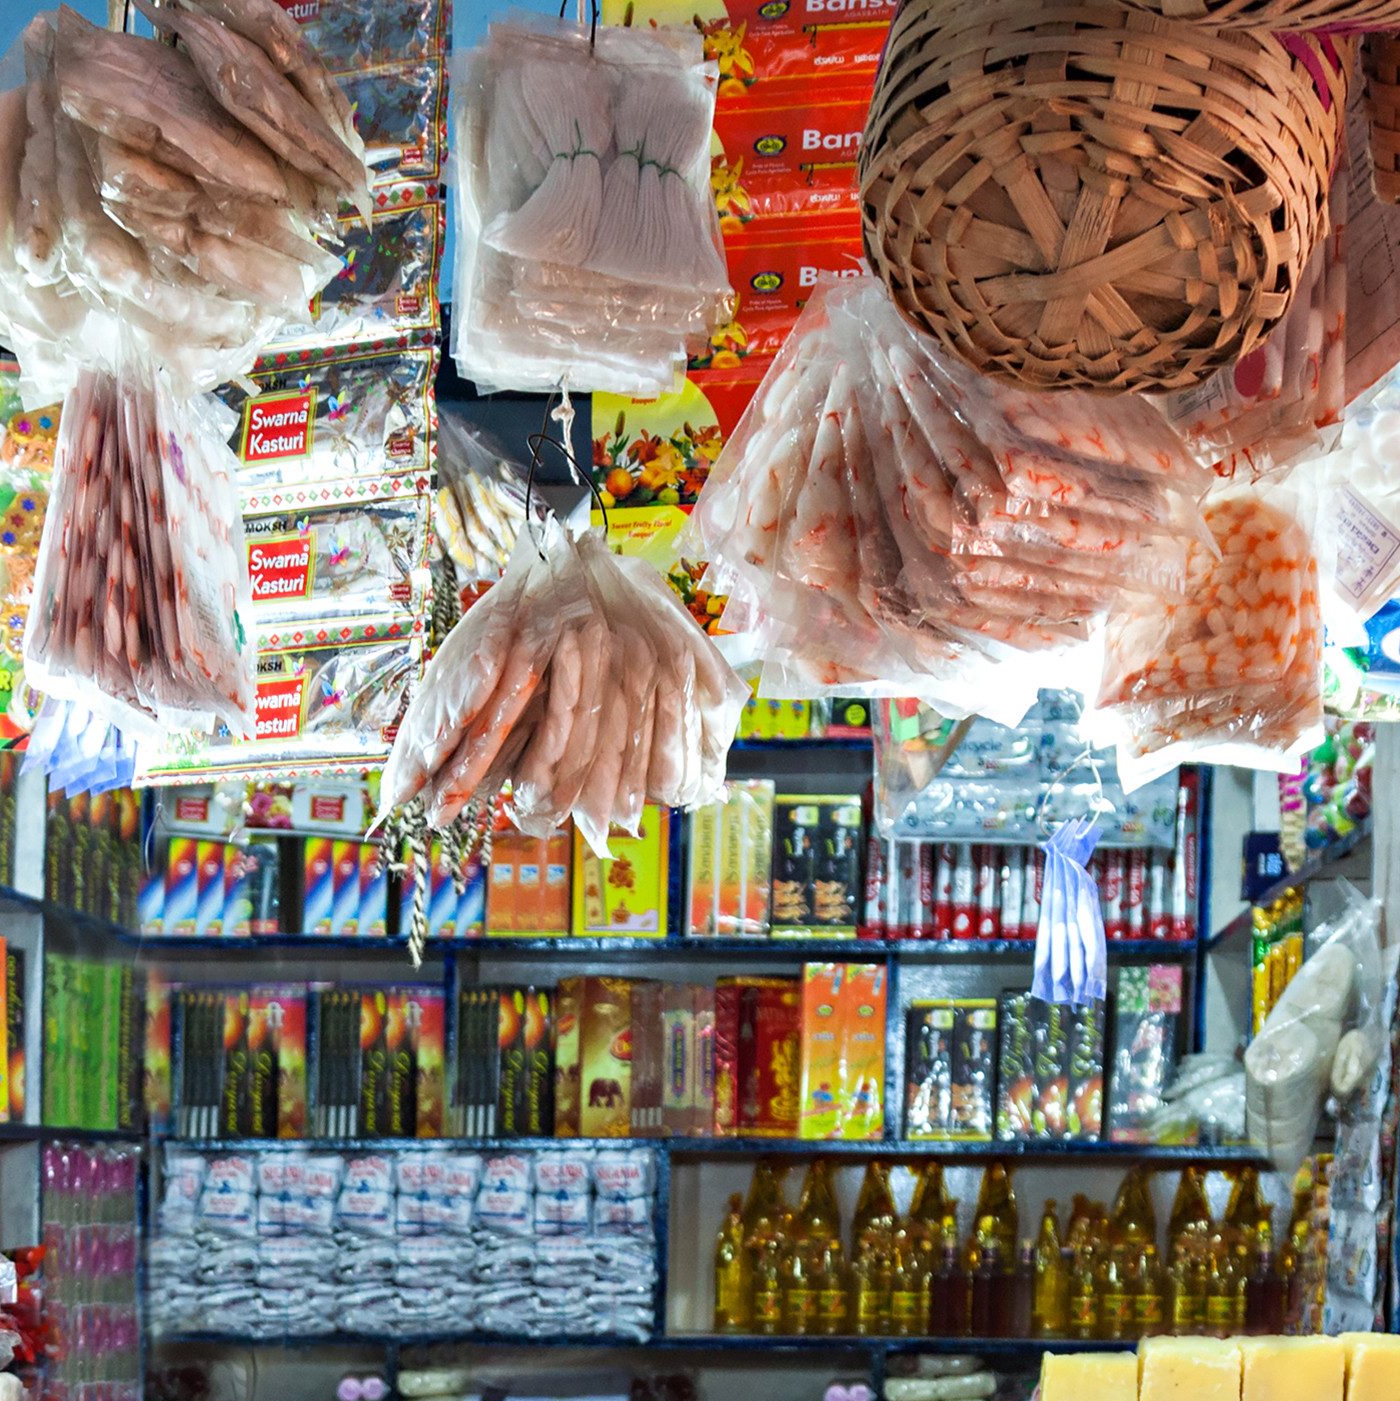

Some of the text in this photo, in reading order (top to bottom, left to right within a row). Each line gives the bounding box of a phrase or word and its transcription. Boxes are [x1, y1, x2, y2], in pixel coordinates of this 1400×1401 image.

[286, 0, 321, 18] sturi
[260, 379, 287, 391] OKSH
[252, 408, 308, 431] Swarna
[250, 433, 304, 456] Kasturi
[245, 521, 287, 533] MOKSH
[251, 550, 309, 571] Swarna
[250, 575, 305, 595] Kasturi
[256, 716, 297, 734] asturi
